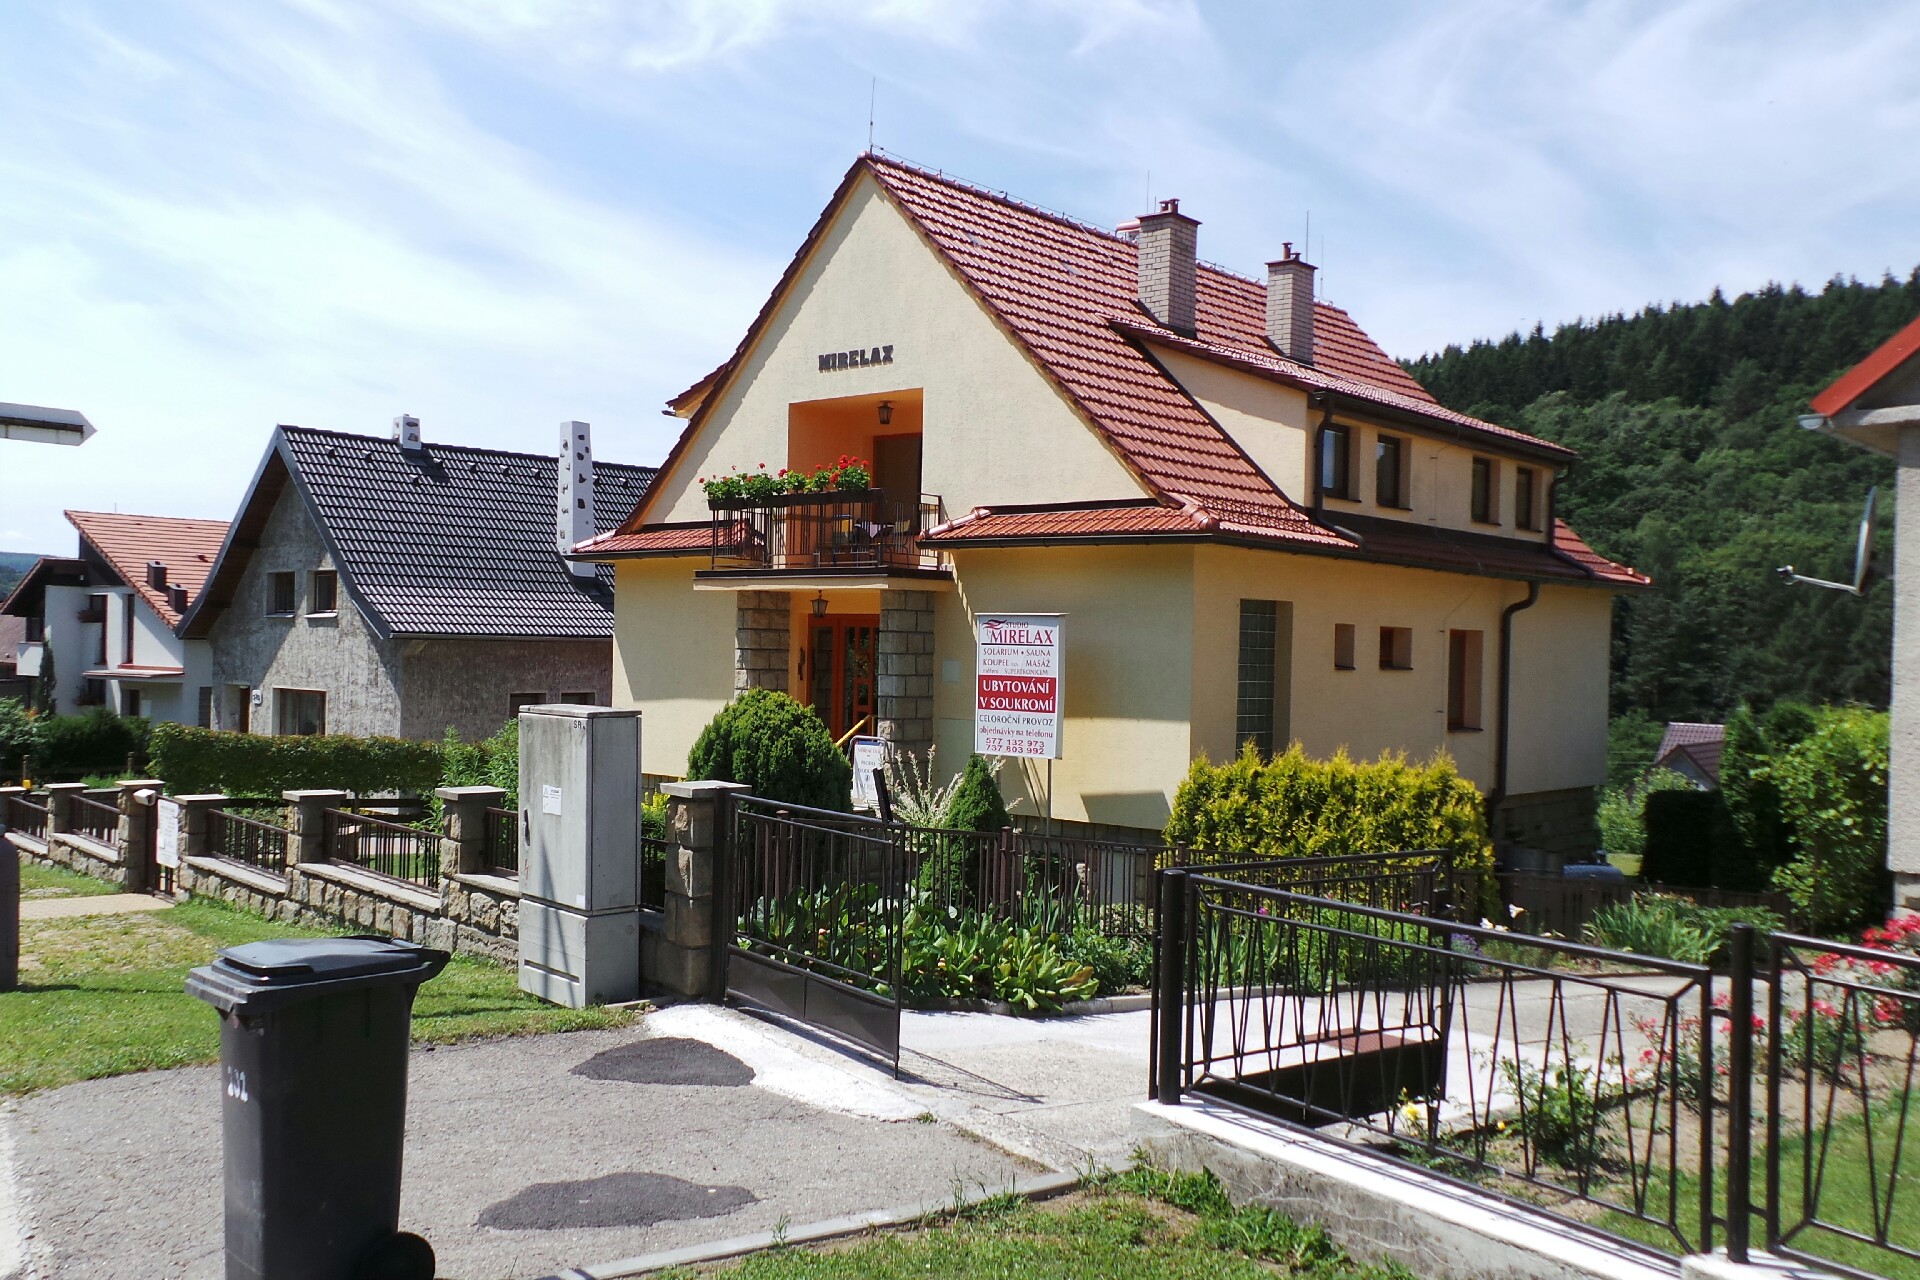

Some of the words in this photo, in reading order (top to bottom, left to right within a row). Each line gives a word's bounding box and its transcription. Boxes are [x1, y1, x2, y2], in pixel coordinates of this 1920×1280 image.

[818, 345, 893, 373] MIRELAX
[1005, 621, 1029, 629] STUDIO
[990, 629, 1053, 644] MIRELAX
[983, 647, 1019, 656] SOLÁRIUM
[983, 658, 1009, 667] KOUPEL
[1025, 658, 1051, 667] MASÁŽ
[983, 678, 1051, 694] UBYTOVÁNÍ
[979, 696, 988, 708] V
[990, 696, 1054, 711] SOUKROMÍ
[979, 714, 1021, 724] CELOROČNÍ
[1022, 717, 1054, 726] PROVOZ
[978, 726, 1014, 737] objednávky
[1025, 729, 1053, 738] telefonu
[986, 737, 1003, 745] 577
[1027, 740, 1045, 748] 973
[986, 744, 1003, 752] 737
[1006, 745, 1024, 753] 803
[1026, 747, 1045, 755] 992
